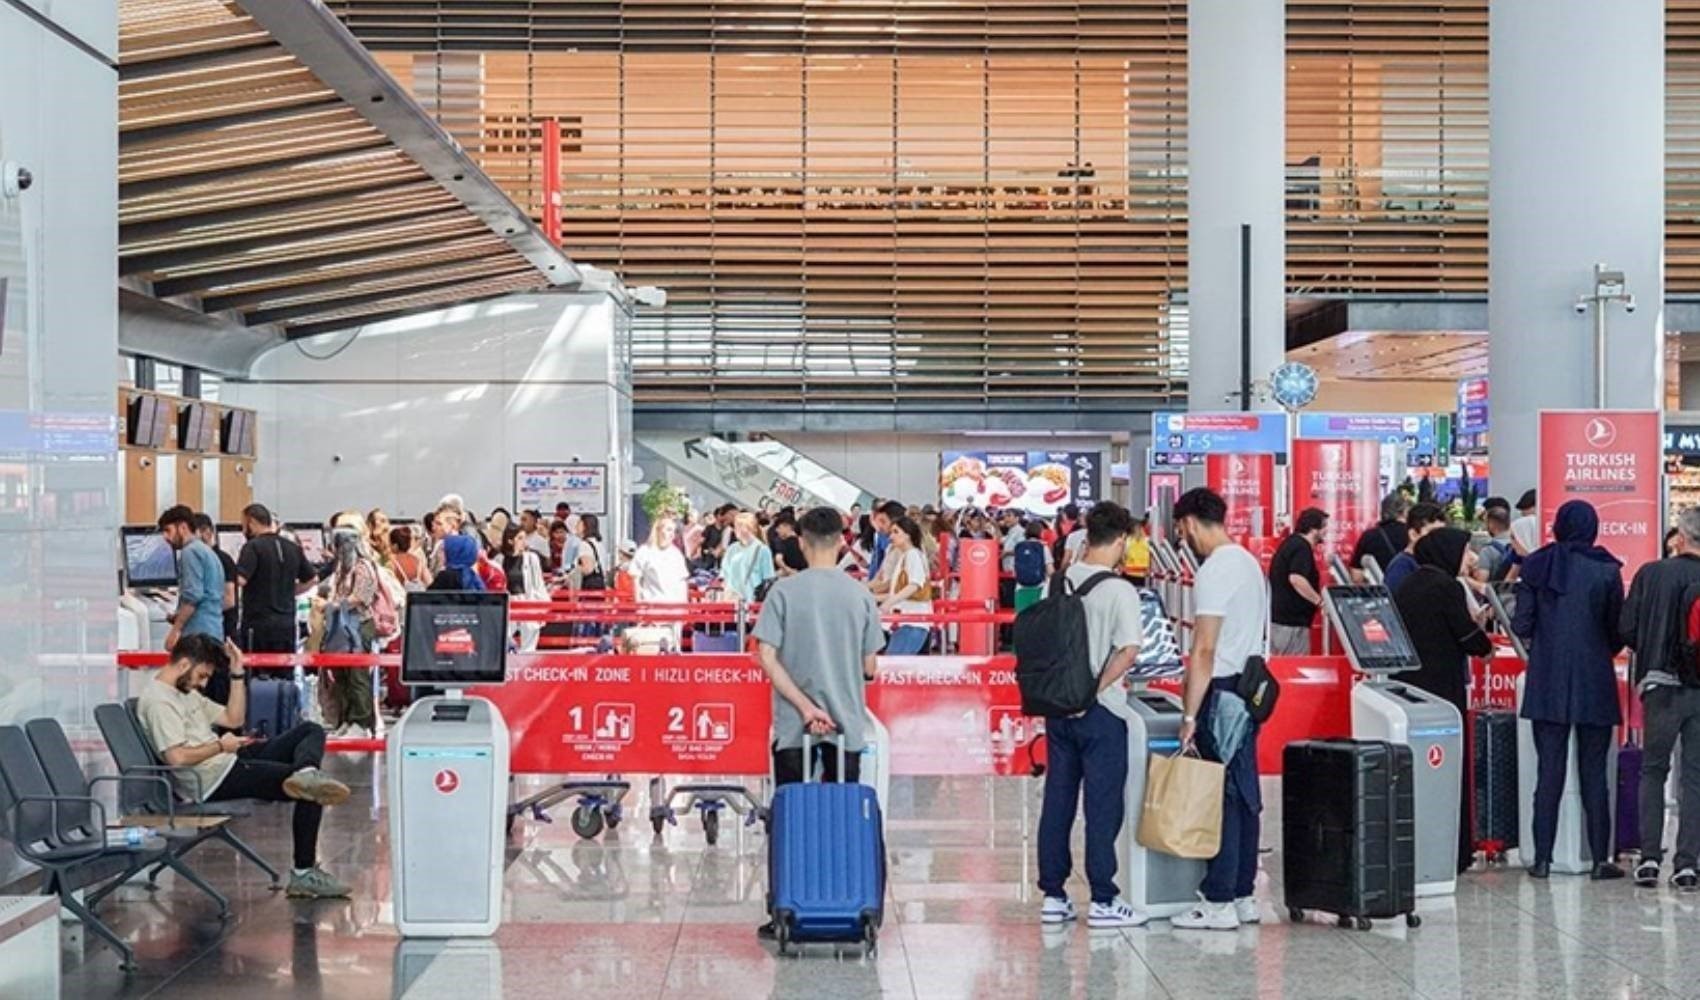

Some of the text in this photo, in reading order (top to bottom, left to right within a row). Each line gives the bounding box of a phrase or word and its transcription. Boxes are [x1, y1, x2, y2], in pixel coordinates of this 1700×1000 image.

[1565, 453, 1636, 466] TURKISH
[1565, 468, 1637, 481] AIRLINES
[505, 668, 521, 681] ST
[524, 667, 588, 682] CHECK-IN
[595, 667, 631, 682] ZONE
[655, 667, 690, 683] HIZLI
[694, 667, 762, 683] CHECK-IN
[880, 671, 1017, 685] FAST CHECK-IN ZON
[568, 706, 582, 731] 1
[668, 707, 684, 731] 2
